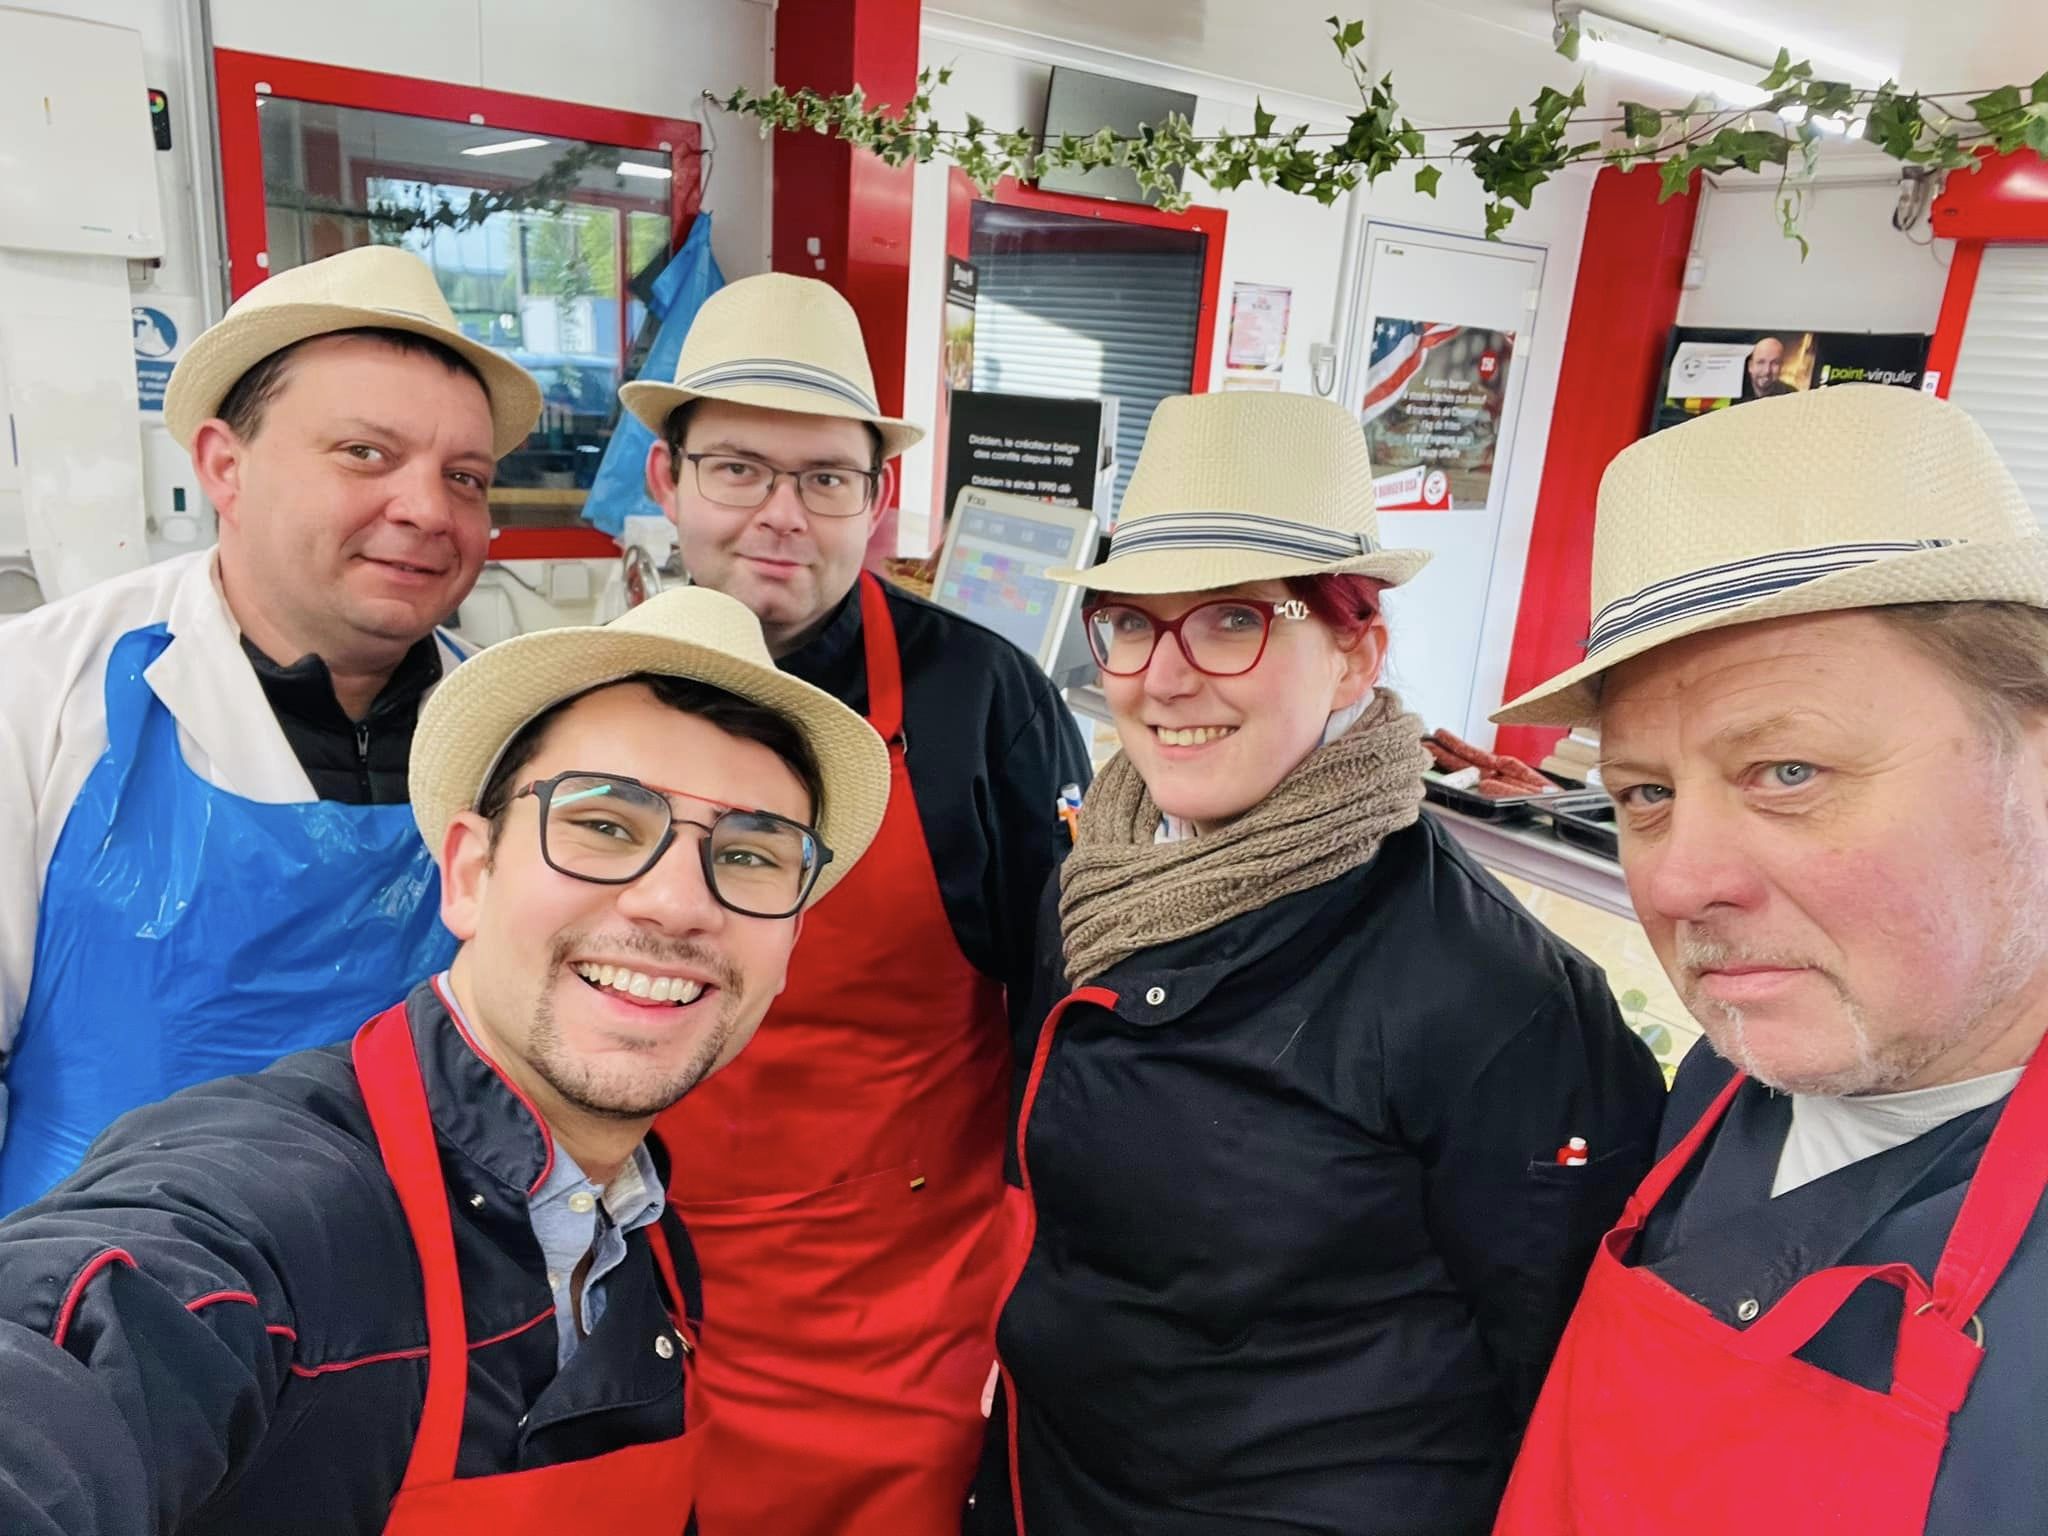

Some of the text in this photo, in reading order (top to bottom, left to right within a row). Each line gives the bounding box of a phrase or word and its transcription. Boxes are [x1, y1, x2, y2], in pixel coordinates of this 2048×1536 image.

[1004, 438, 1014, 448] le
[1014, 439, 1052, 451] créateur
[1052, 443, 1080, 455] belge
[973, 449, 1074, 467] des confits depuis 1990
[1013, 479, 1036, 490] sinds
[1037, 481, 1057, 493] 1990
